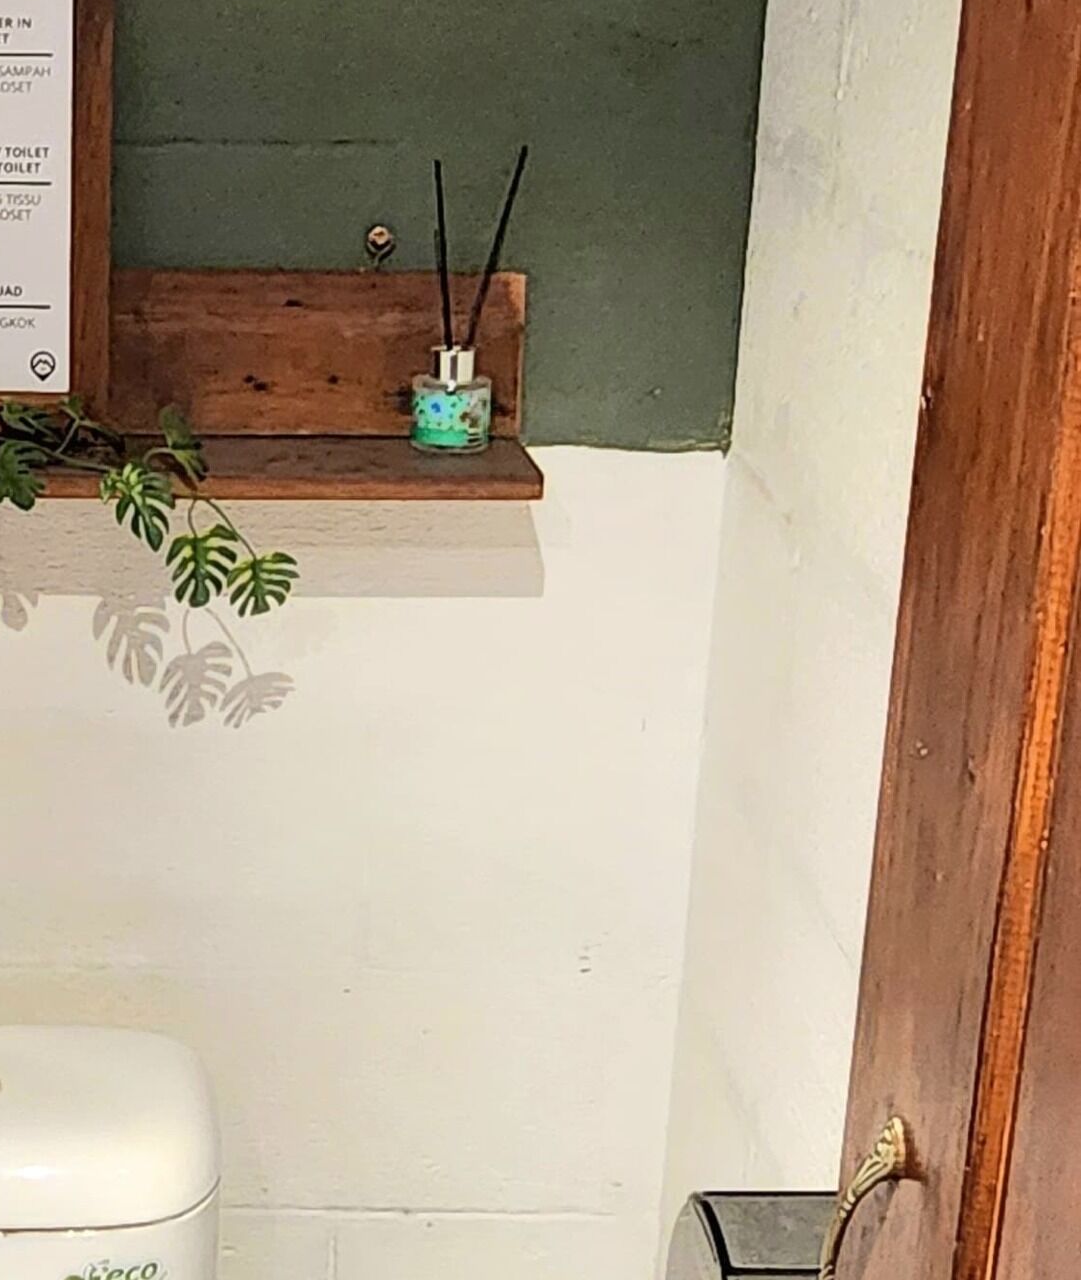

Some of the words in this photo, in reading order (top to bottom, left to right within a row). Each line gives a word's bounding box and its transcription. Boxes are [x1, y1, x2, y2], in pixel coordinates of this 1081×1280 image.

[17, 17, 33, 29] IN
[5, 147, 50, 159] TOILET
[7, 194, 41, 206] TISSU
